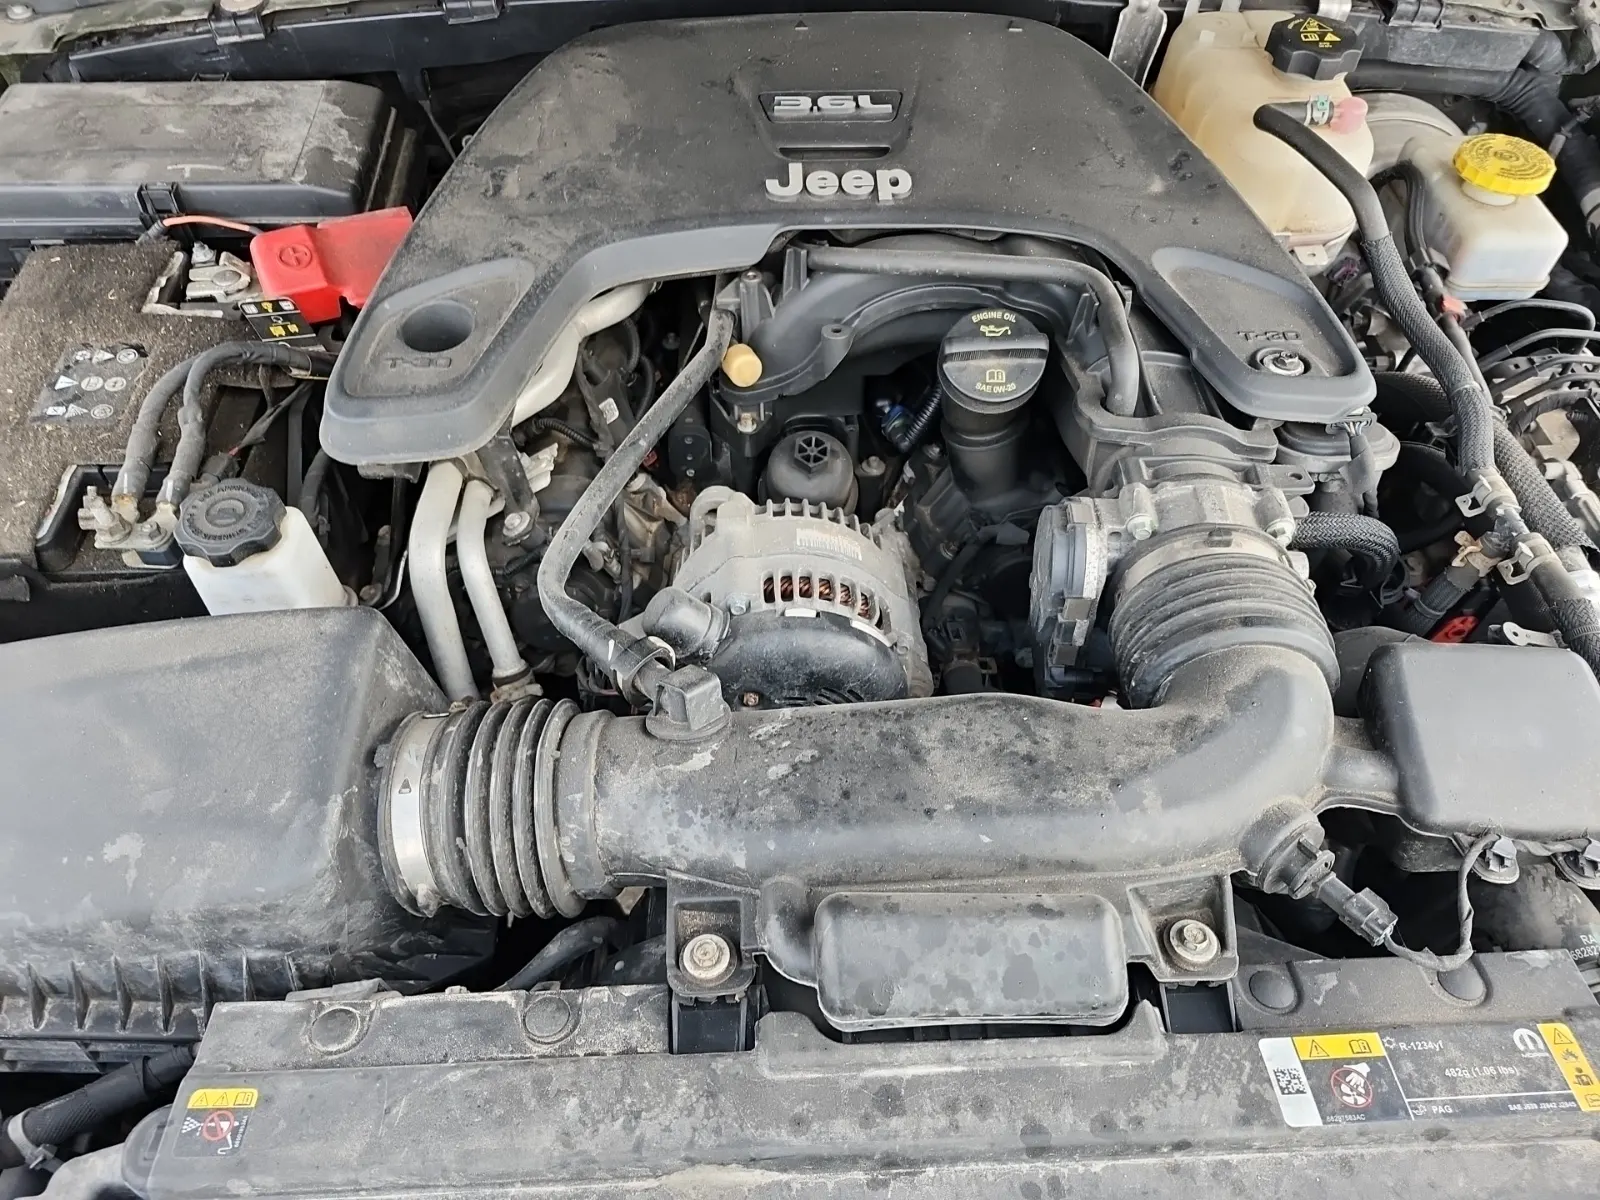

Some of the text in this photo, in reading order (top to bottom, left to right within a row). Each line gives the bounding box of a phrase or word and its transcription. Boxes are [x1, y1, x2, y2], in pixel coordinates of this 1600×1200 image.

[774, 95, 892, 115] 3.6L
[765, 163, 913, 204] Jeep
[971, 311, 1017, 323] ENGINE OIL
[975, 382, 1017, 394] SAE 0W-20
[1399, 1039, 1444, 1052] R-1234yf
[1444, 1065, 1519, 1078] 482g (1.06 lbs)
[1431, 1105, 1453, 1114] PAG
